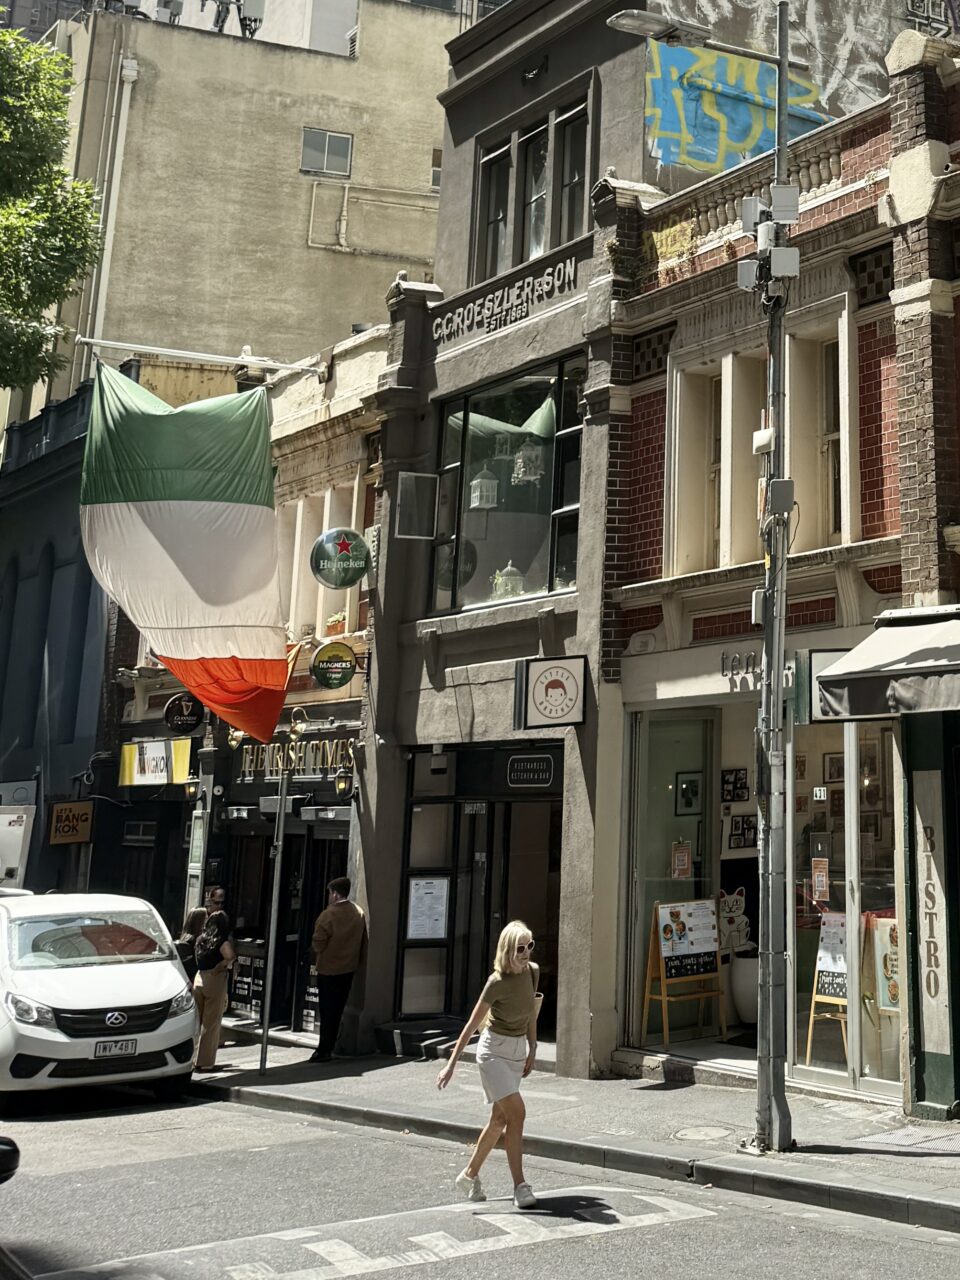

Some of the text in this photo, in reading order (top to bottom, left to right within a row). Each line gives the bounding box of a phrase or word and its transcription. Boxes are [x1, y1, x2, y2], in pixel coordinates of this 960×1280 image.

[543, 257, 576, 292] SON
[319, 558, 365, 569] Heineken
[539, 670, 570, 685] LITTLE
[539, 697, 574, 715] BROTHER
[242, 738, 355, 770] THE IRISH TIMES
[55, 823, 79, 834] KOK
[922, 825, 940, 999] BISTRO
